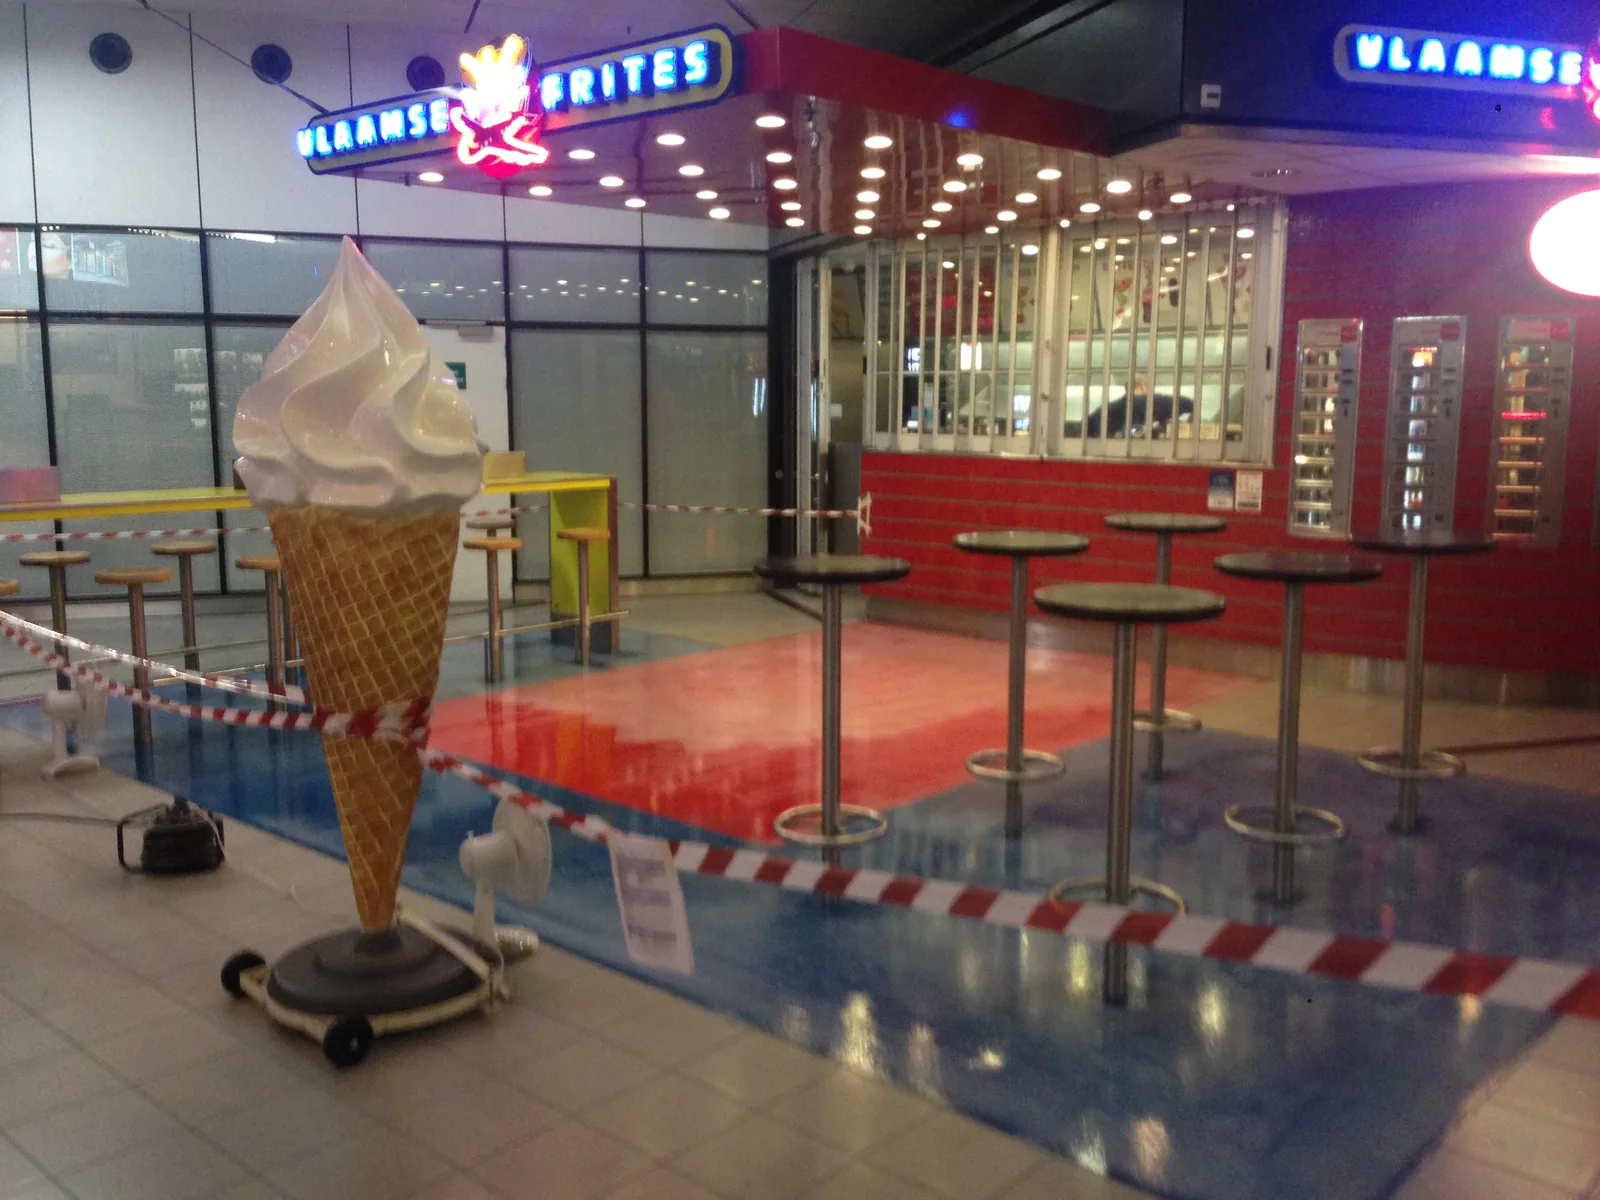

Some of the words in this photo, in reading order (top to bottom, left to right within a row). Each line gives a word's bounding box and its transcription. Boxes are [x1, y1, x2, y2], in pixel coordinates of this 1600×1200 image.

[297, 98, 448, 160] VLAAMSE
[540, 40, 708, 111] FRITES
[1355, 32, 1583, 85] VLAAMSE
